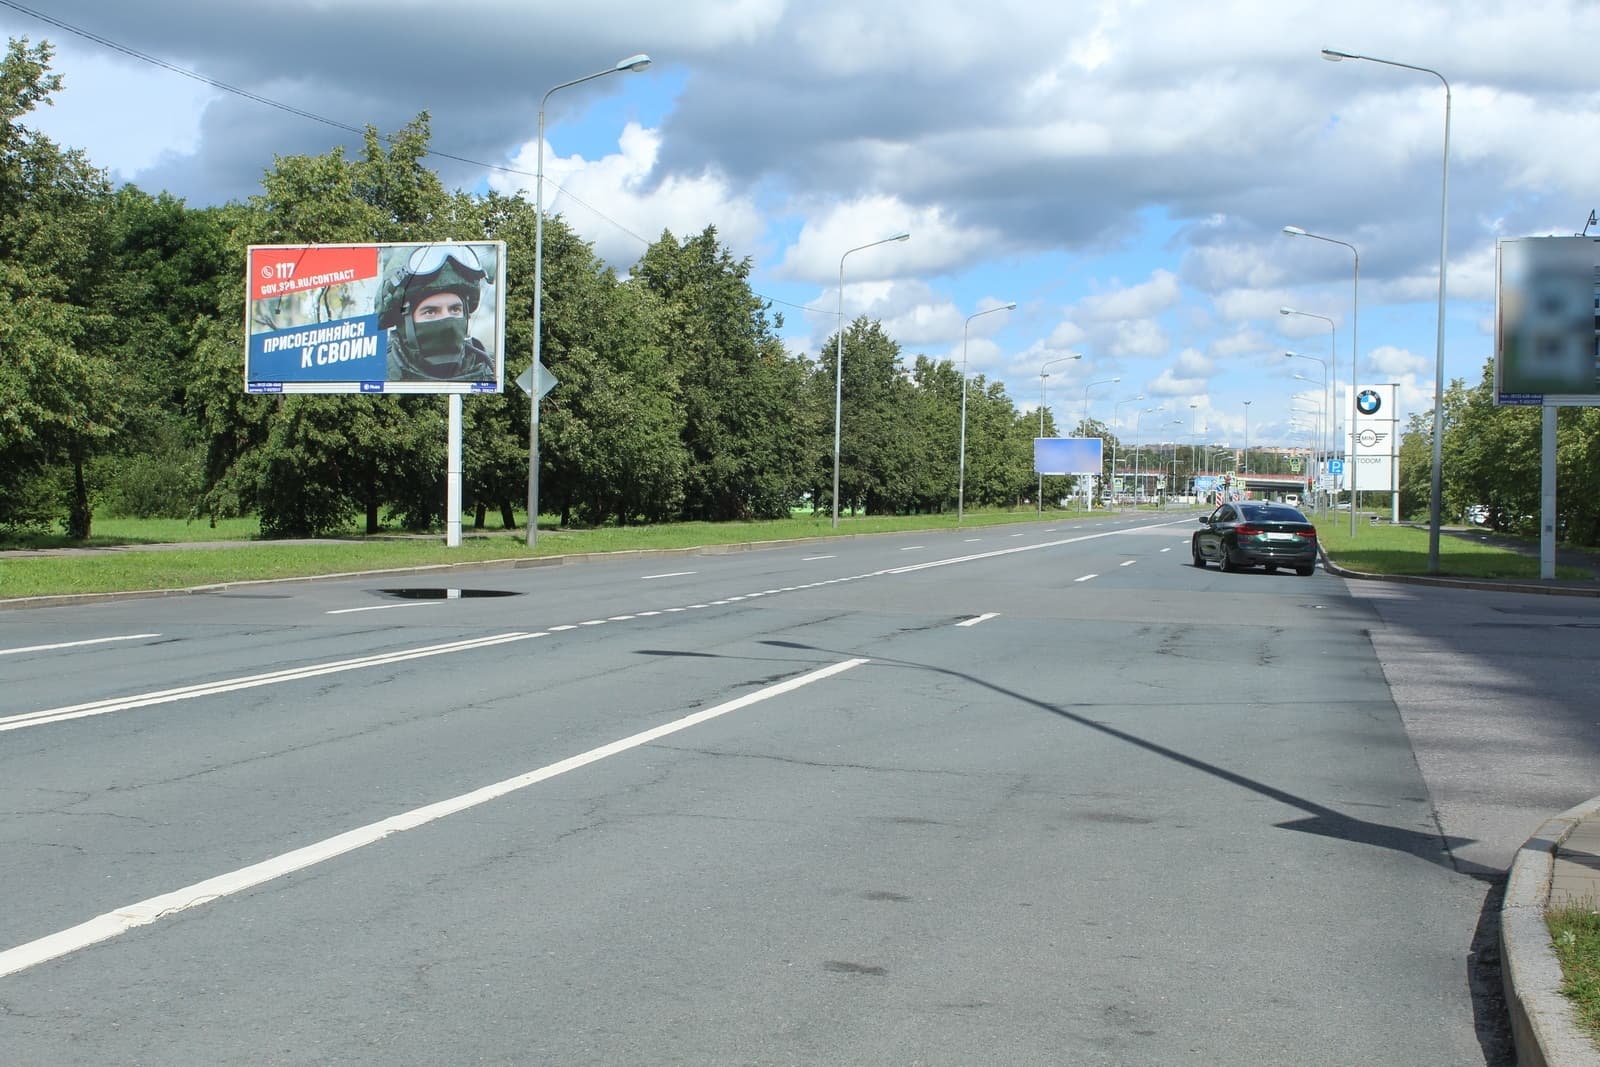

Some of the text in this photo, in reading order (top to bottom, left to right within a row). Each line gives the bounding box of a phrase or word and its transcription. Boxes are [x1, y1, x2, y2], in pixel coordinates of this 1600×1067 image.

[261, 269, 355, 295] GOV.SPB.RU/CONTRACT
[275, 262, 295, 279] 117
[264, 320, 366, 353] ПРИСОЕДИНЯЙСЯ
[301, 335, 378, 369] К СВОИМ
